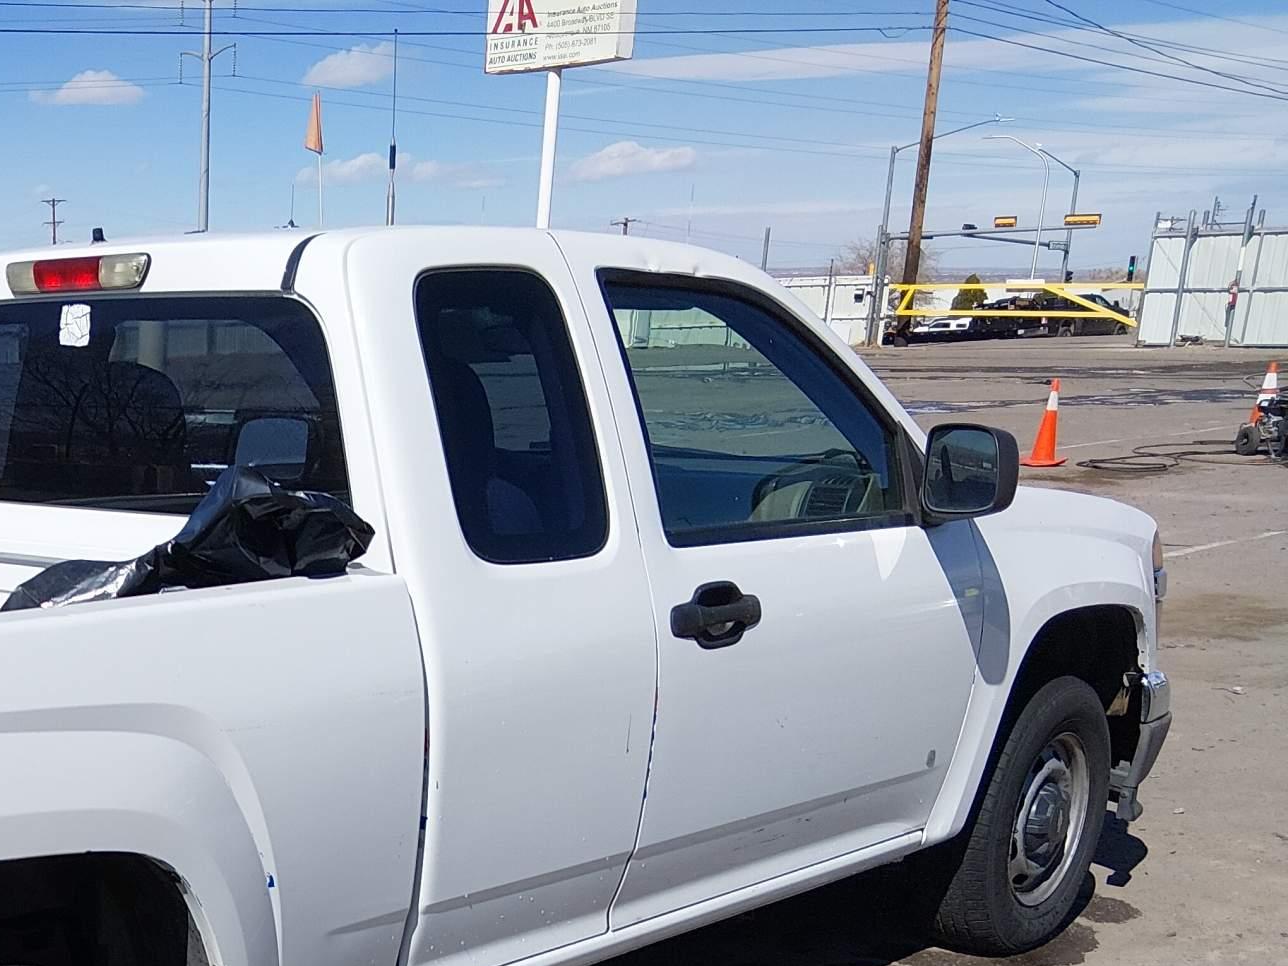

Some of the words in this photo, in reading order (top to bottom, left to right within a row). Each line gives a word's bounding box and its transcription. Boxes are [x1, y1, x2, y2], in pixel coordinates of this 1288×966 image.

[577, 5, 590, 14] Auto
[592, 2, 618, 11] Auctions
[489, 37, 538, 51] INSURANCE
[488, 55, 505, 65] AUTO
[506, 51, 537, 62] AUCTIONS
